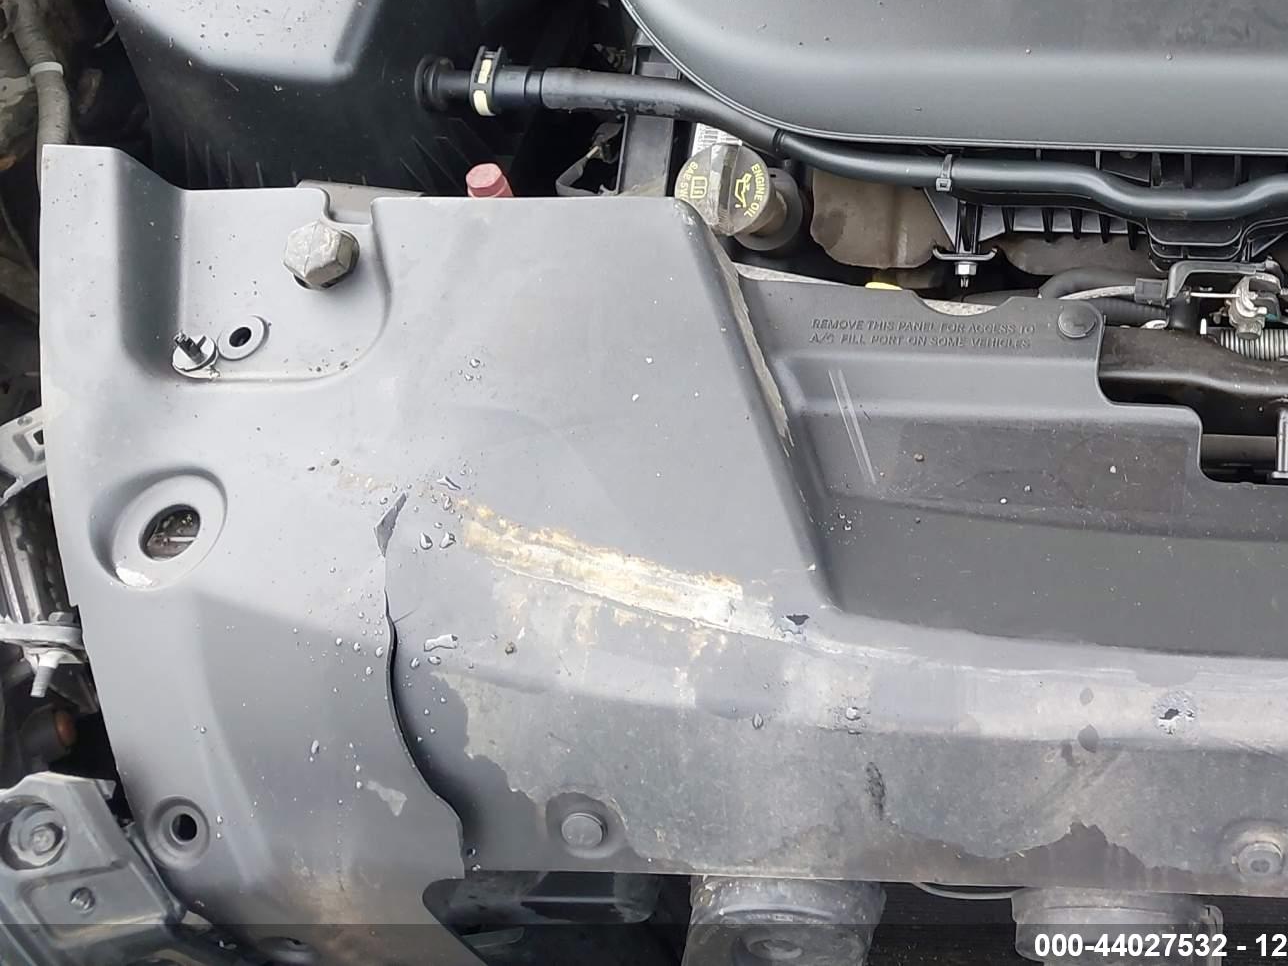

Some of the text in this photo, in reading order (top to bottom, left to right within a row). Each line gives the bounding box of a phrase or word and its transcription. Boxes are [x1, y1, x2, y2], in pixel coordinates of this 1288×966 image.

[683, 161, 698, 180] SAE
[743, 163, 765, 217] ENGINE OIL
[812, 319, 864, 331] REMOVE
[867, 320, 895, 331] THIS
[897, 321, 935, 332] PANEL
[940, 322, 965, 333] FOR
[968, 322, 1017, 334] ACCESS
[841, 334, 866, 345] FILL
[871, 335, 904, 346] PORT
[907, 336, 928, 346] ON
[928, 336, 965, 347] SOME
